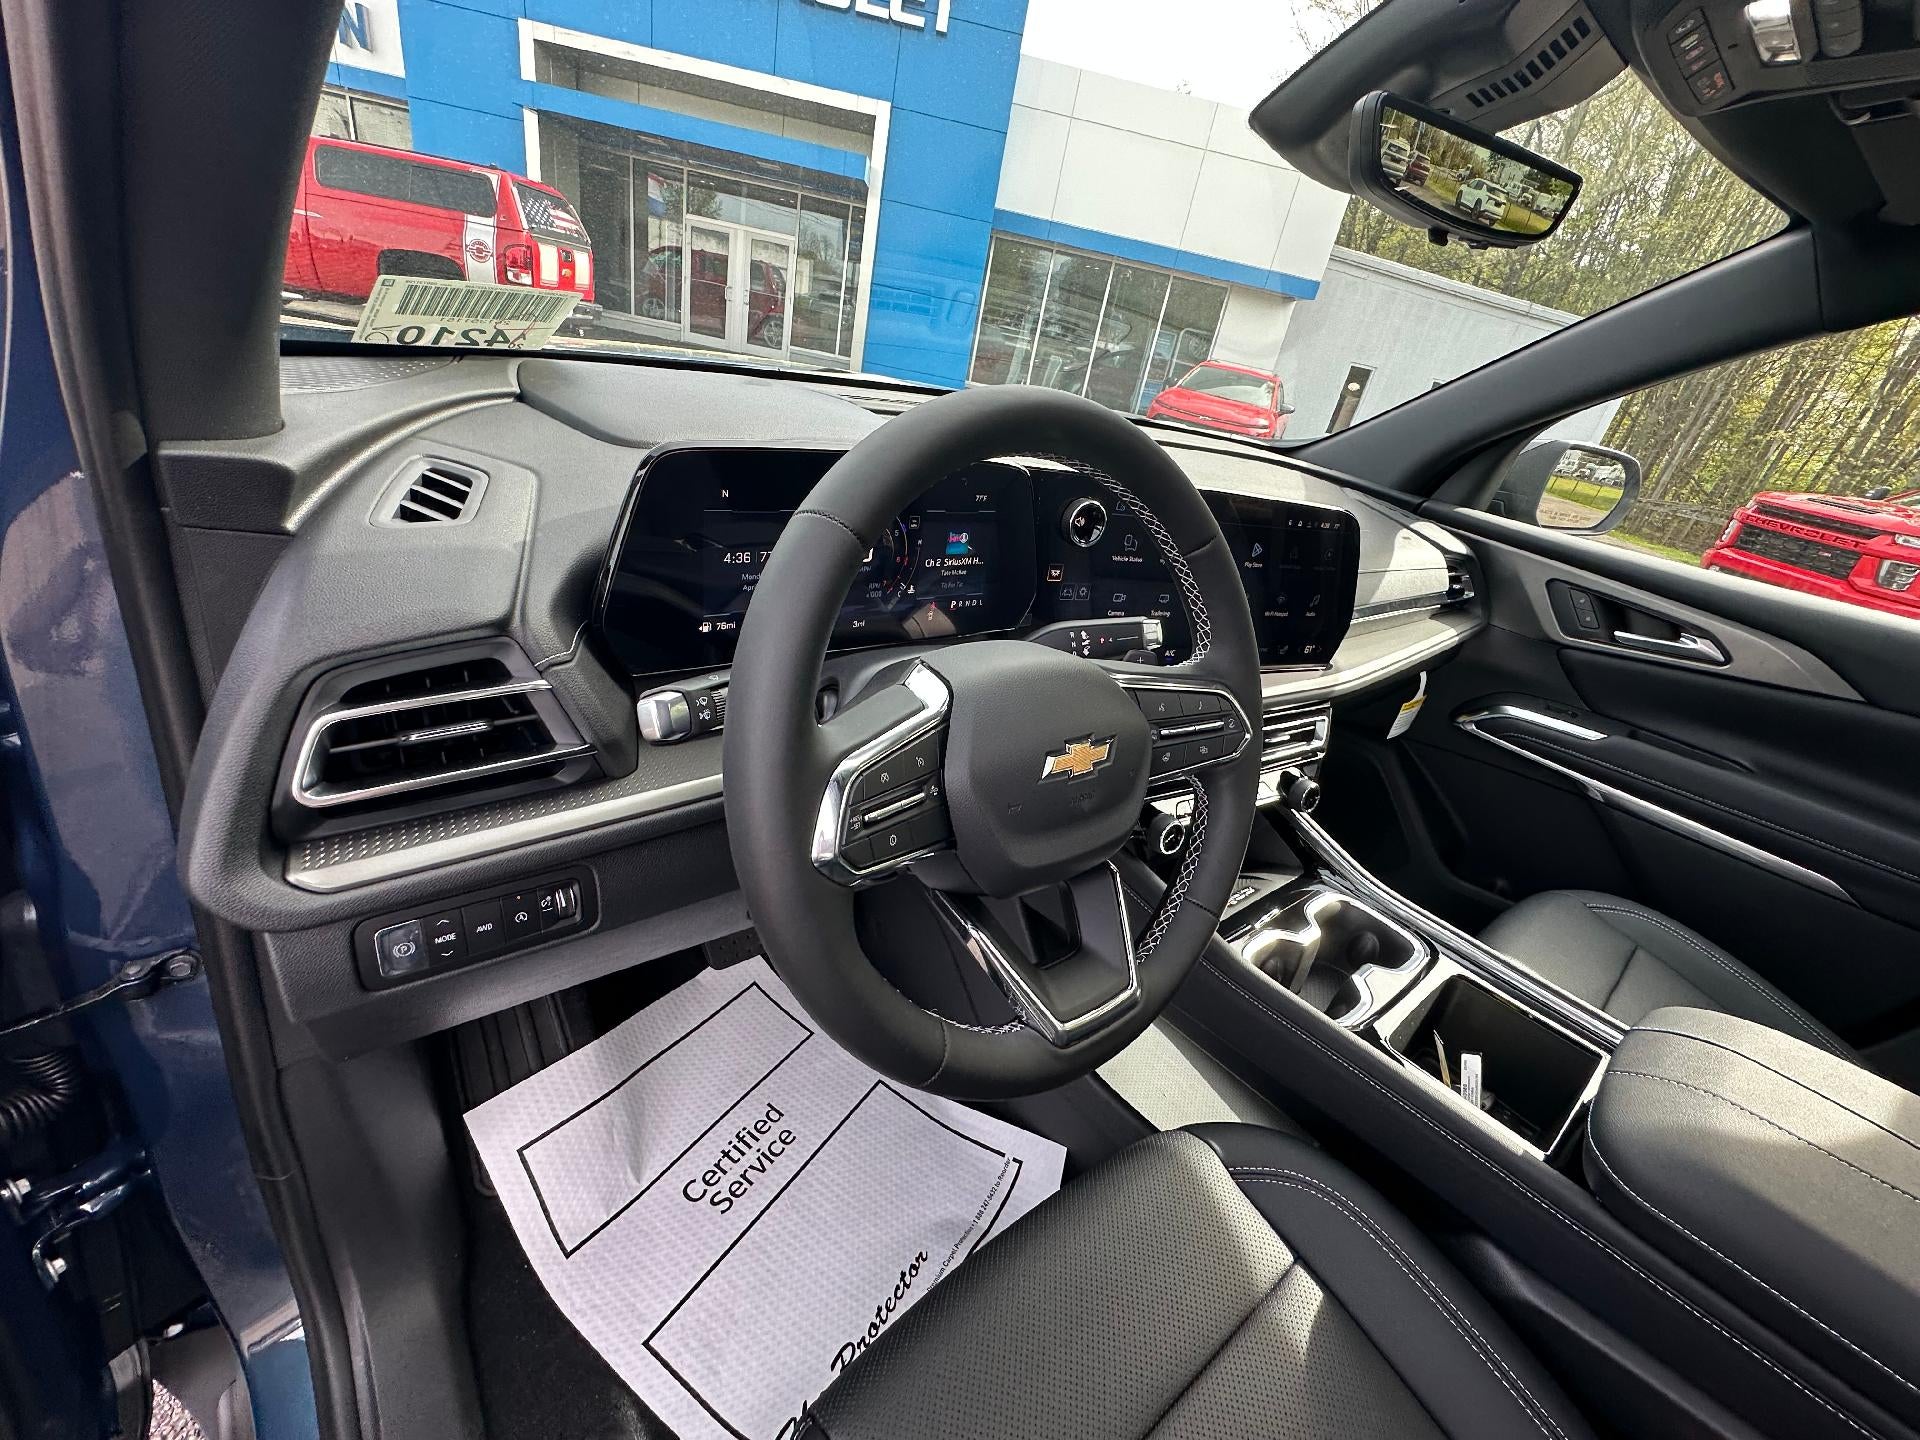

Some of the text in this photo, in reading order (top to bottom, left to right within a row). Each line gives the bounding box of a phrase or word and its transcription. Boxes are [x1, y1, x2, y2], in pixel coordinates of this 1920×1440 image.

[721, 489, 729, 498] N
[1745, 515, 1867, 549] CHEVROLET
[723, 551, 751, 564] 4:36
[925, 558, 935, 568] Ch
[935, 558, 942, 567] 2
[943, 557, 972, 567] SiriusXM
[716, 621, 736, 631] 76mi
[476, 922, 493, 934] AWD
[434, 932, 457, 945] MODE
[682, 1102, 785, 1203] Certified
[709, 1129, 797, 1215] Service
[942, 1247, 958, 1268] Carpet
[953, 1224, 975, 1250] Protection
[997, 1156, 1011, 1182] Reorder
[830, 1250, 929, 1374] Protector
